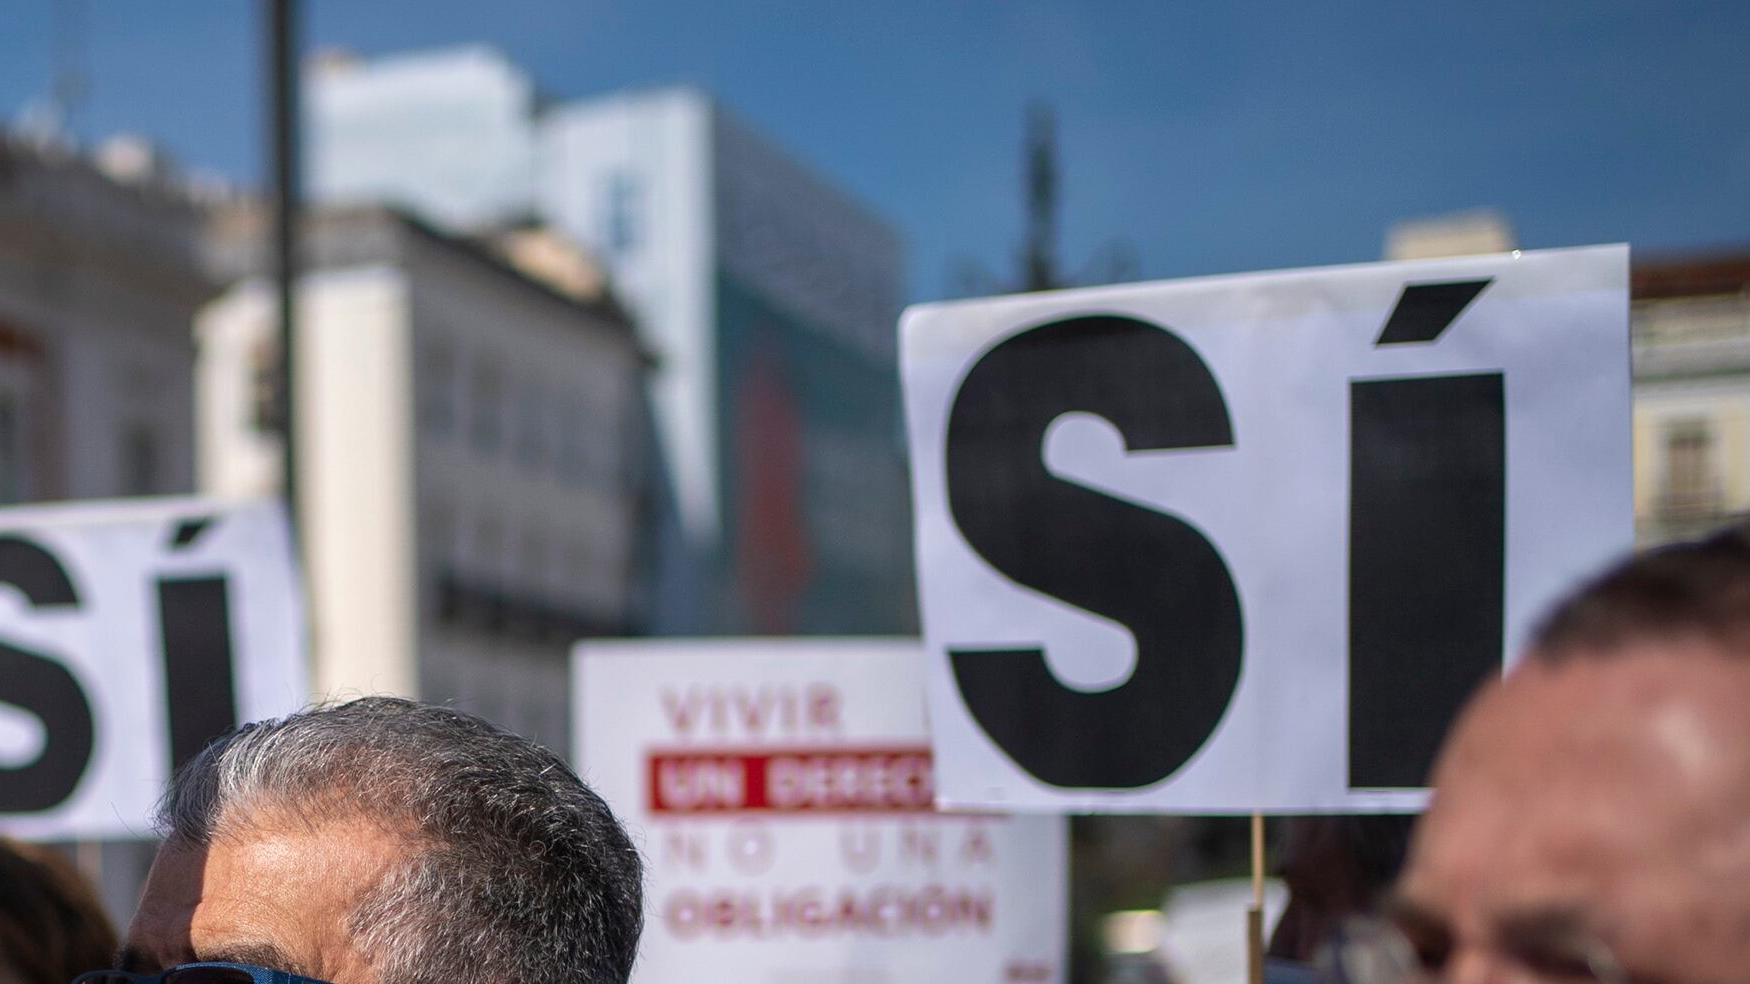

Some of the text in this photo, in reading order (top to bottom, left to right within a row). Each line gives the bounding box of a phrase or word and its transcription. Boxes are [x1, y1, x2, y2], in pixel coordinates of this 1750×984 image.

[944, 277, 1505, 790] SÍ
[659, 681, 844, 734] VIVIR
[658, 755, 746, 810] UN
[662, 823, 997, 875] NO UNA
[664, 884, 997, 941] OBLIGACIÓN
